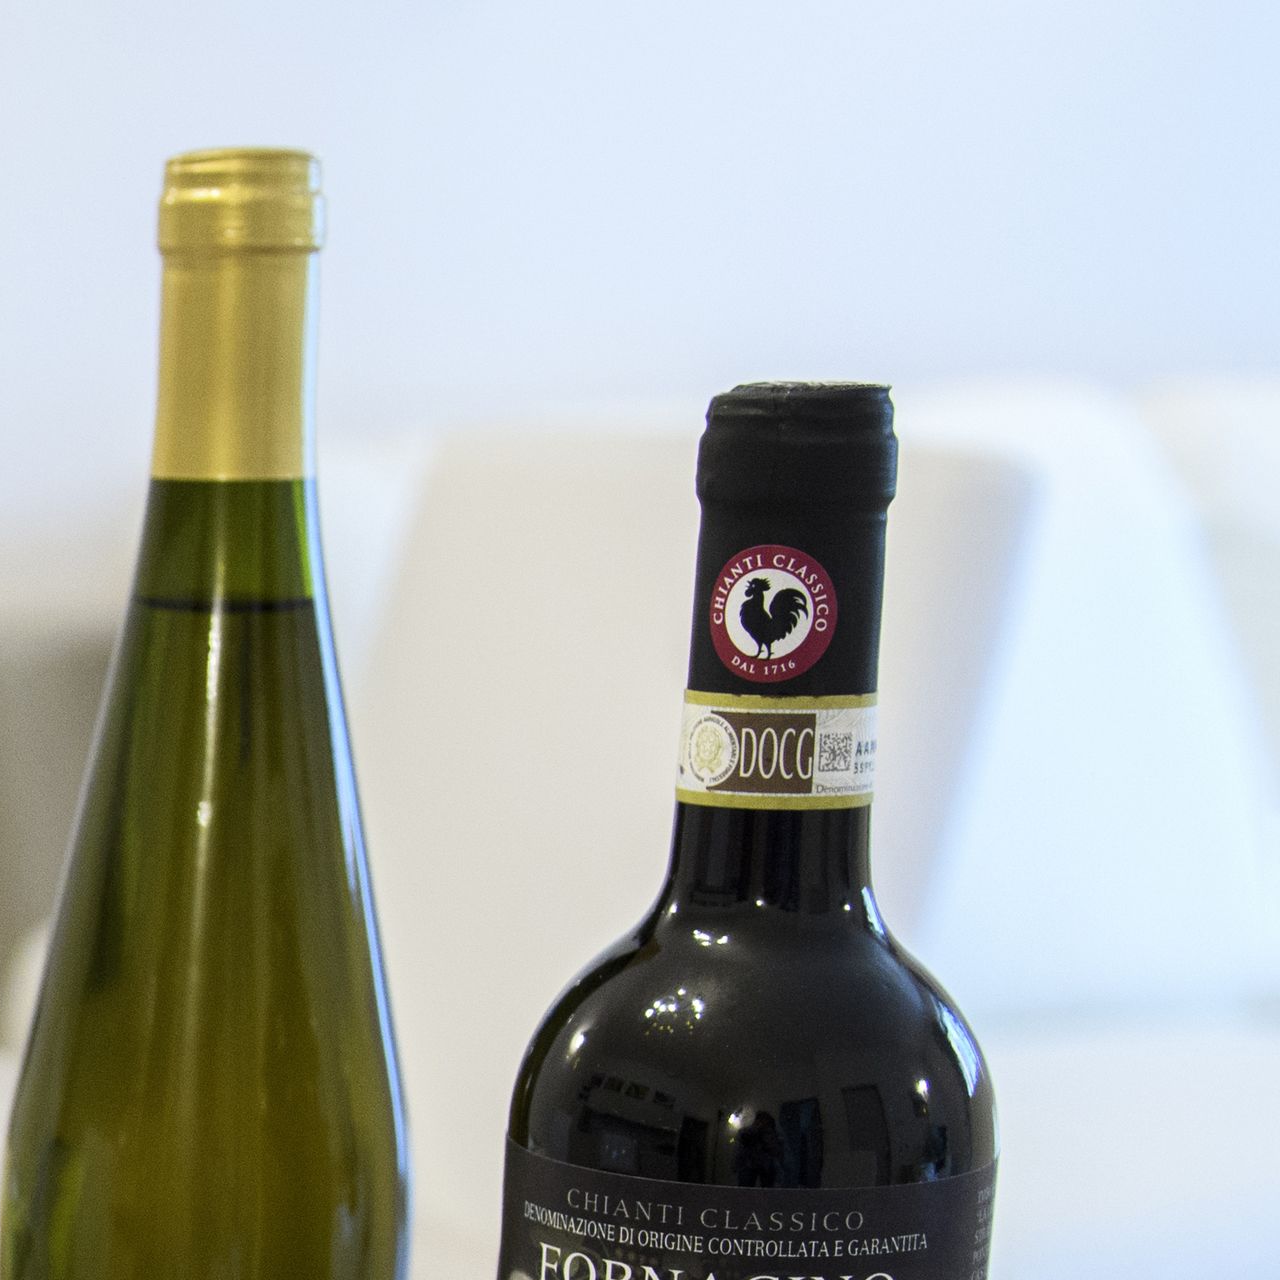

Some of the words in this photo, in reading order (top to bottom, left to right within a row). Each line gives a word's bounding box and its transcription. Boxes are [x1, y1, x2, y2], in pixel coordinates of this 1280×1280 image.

[713, 554, 763, 625] CHIANTI
[772, 554, 829, 632] CLASSICO
[731, 655, 756, 674] DAL
[763, 660, 796, 676] 1716
[739, 727, 814, 780] DOCG
[524, 1199, 616, 1243] DENOMINAZIONE
[618, 1225, 635, 1246] DI
[637, 1229, 704, 1254] ORIGINE
[707, 1236, 830, 1258] CONTROLLATA
[834, 1239, 844, 1258] E
[847, 1232, 929, 1257] GARANTITA
[566, 1187, 684, 1226] CHIANTI
[699, 1207, 865, 1233] CLASSICO
